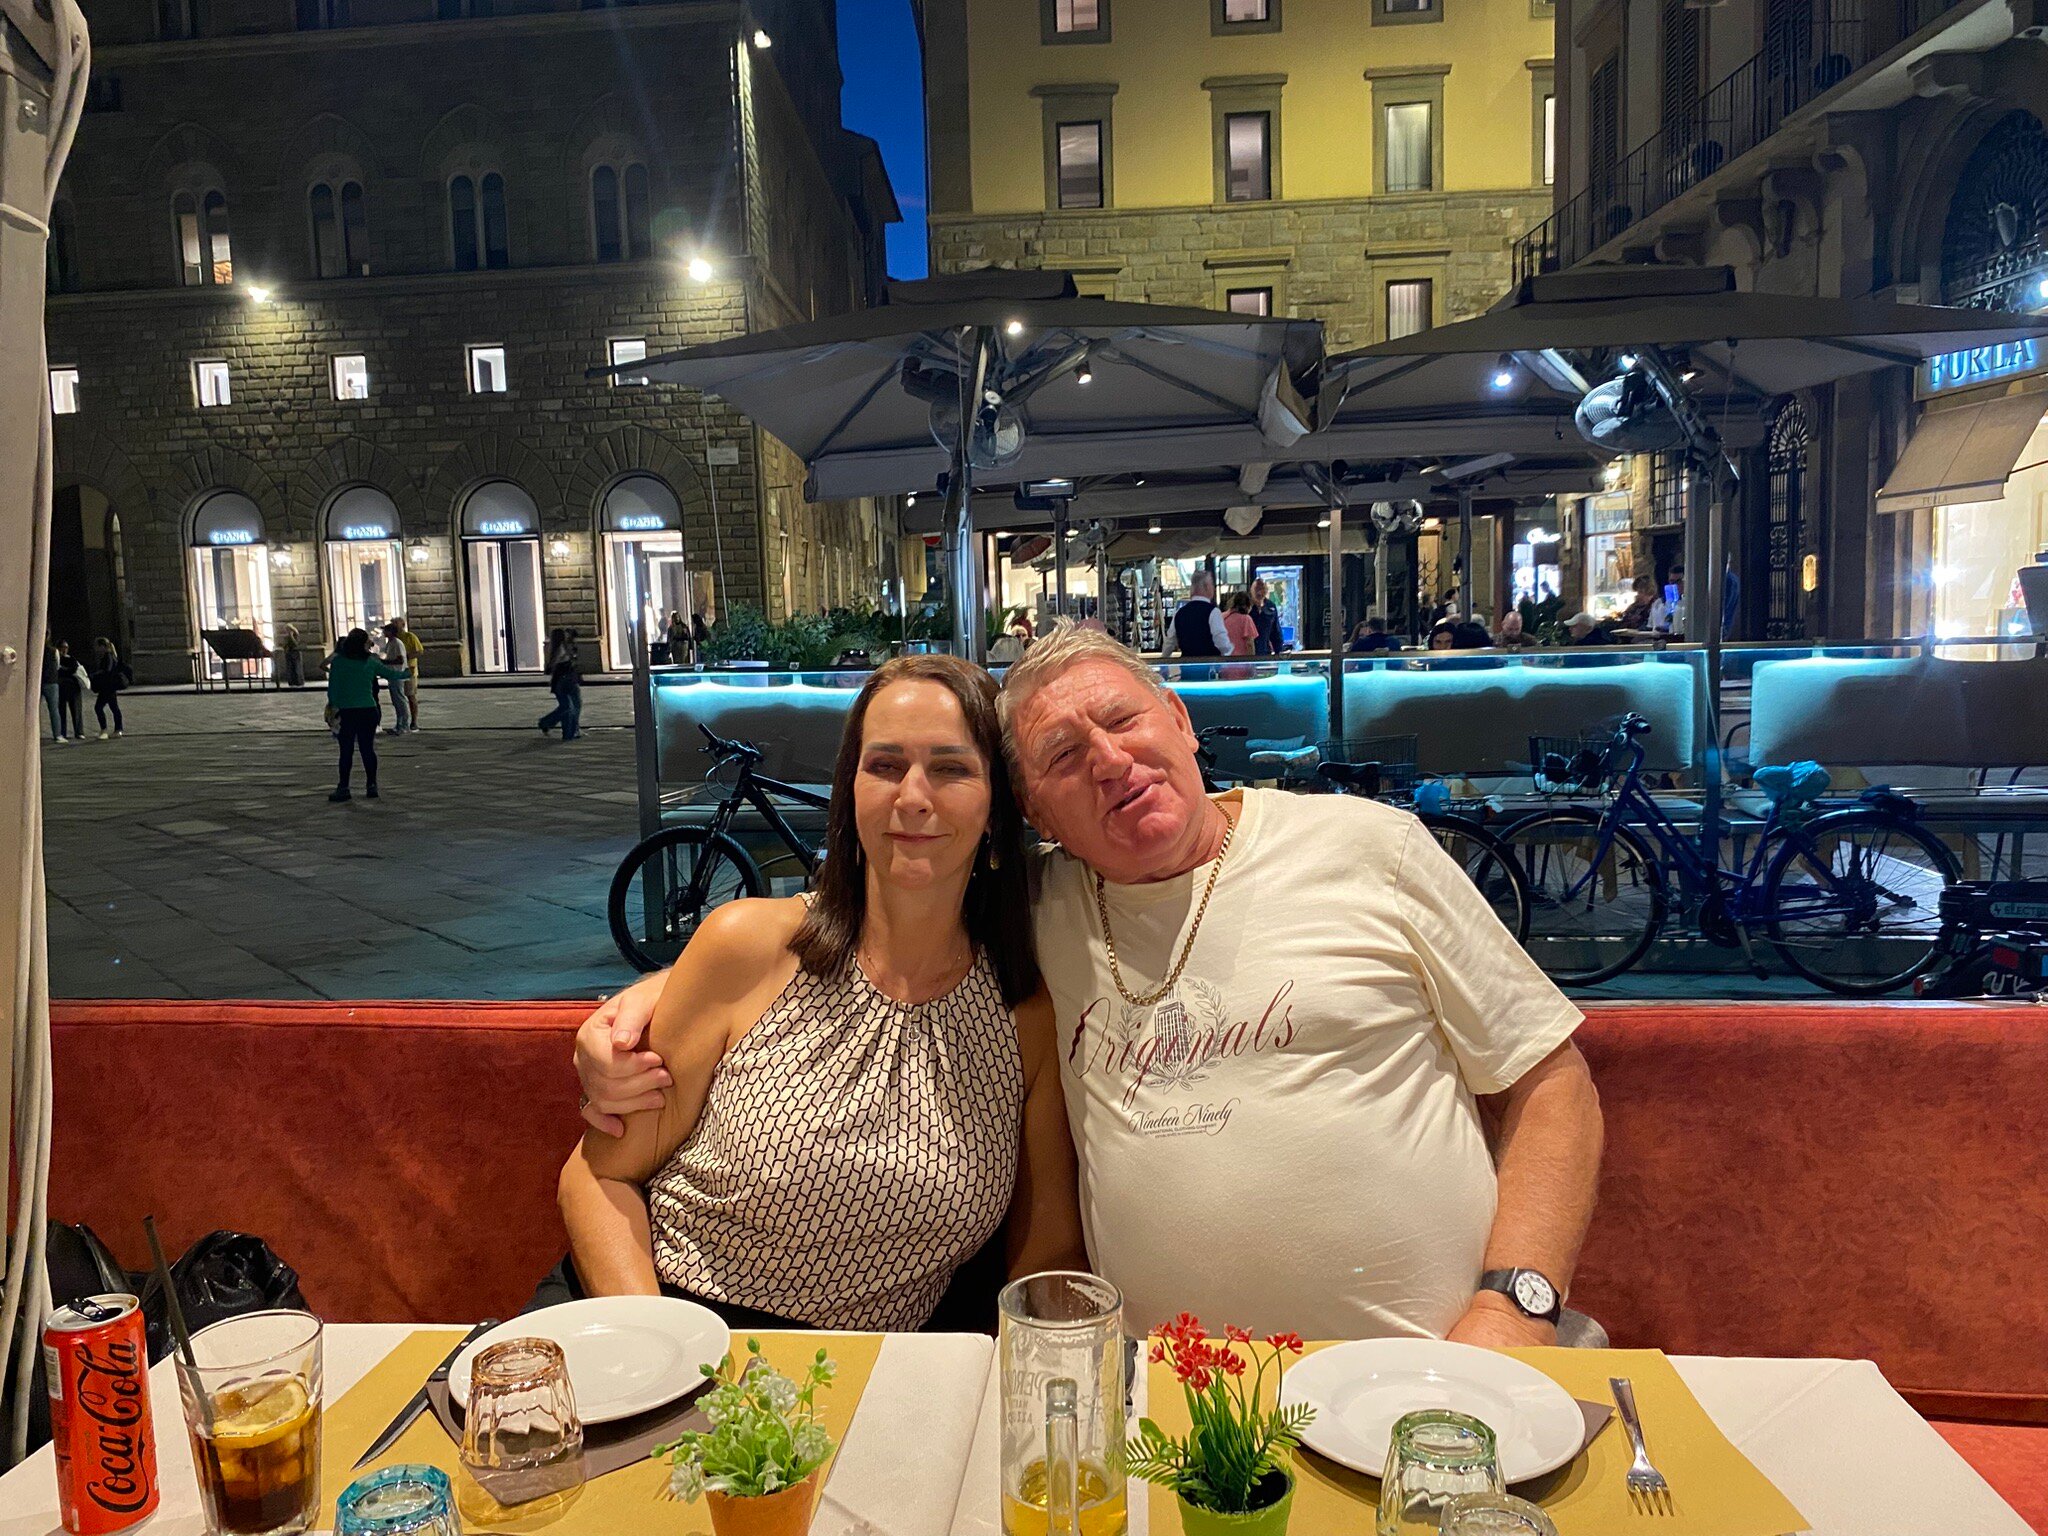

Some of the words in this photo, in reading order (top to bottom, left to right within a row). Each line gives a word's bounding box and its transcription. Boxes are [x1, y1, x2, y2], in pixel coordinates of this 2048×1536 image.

[1931, 339, 2034, 385] FURLA
[345, 525, 387, 539] CHANEL
[480, 521, 523, 534] CHANEL
[620, 516, 664, 529] CHANEL
[211, 531, 253, 544] CHANEL
[1068, 979, 1303, 1112] Originals
[1183, 1097, 1241, 1137] Ninety
[75, 1338, 150, 1513] Coca-Cola
